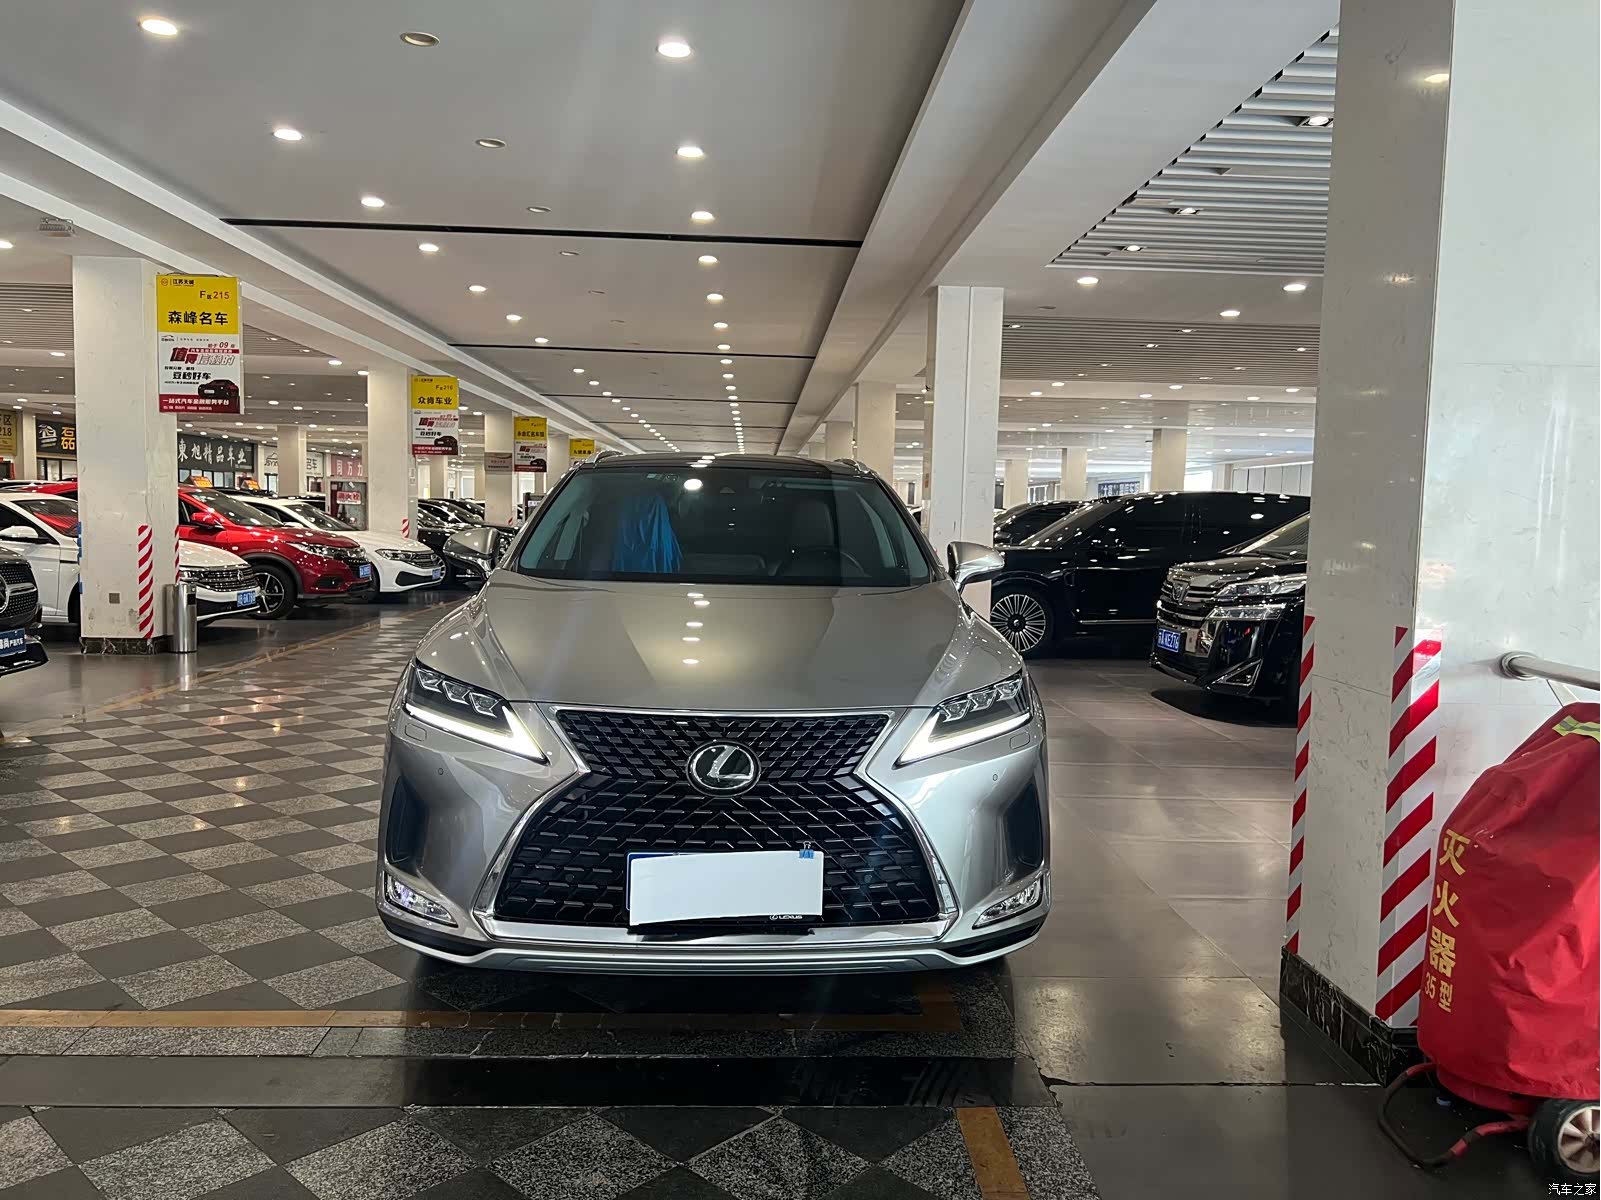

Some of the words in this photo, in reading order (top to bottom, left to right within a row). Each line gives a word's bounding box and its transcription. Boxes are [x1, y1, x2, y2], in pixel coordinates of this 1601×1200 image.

[168, 310, 228, 325] 森峰名车
[1429, 828, 1471, 978] 灭火器
